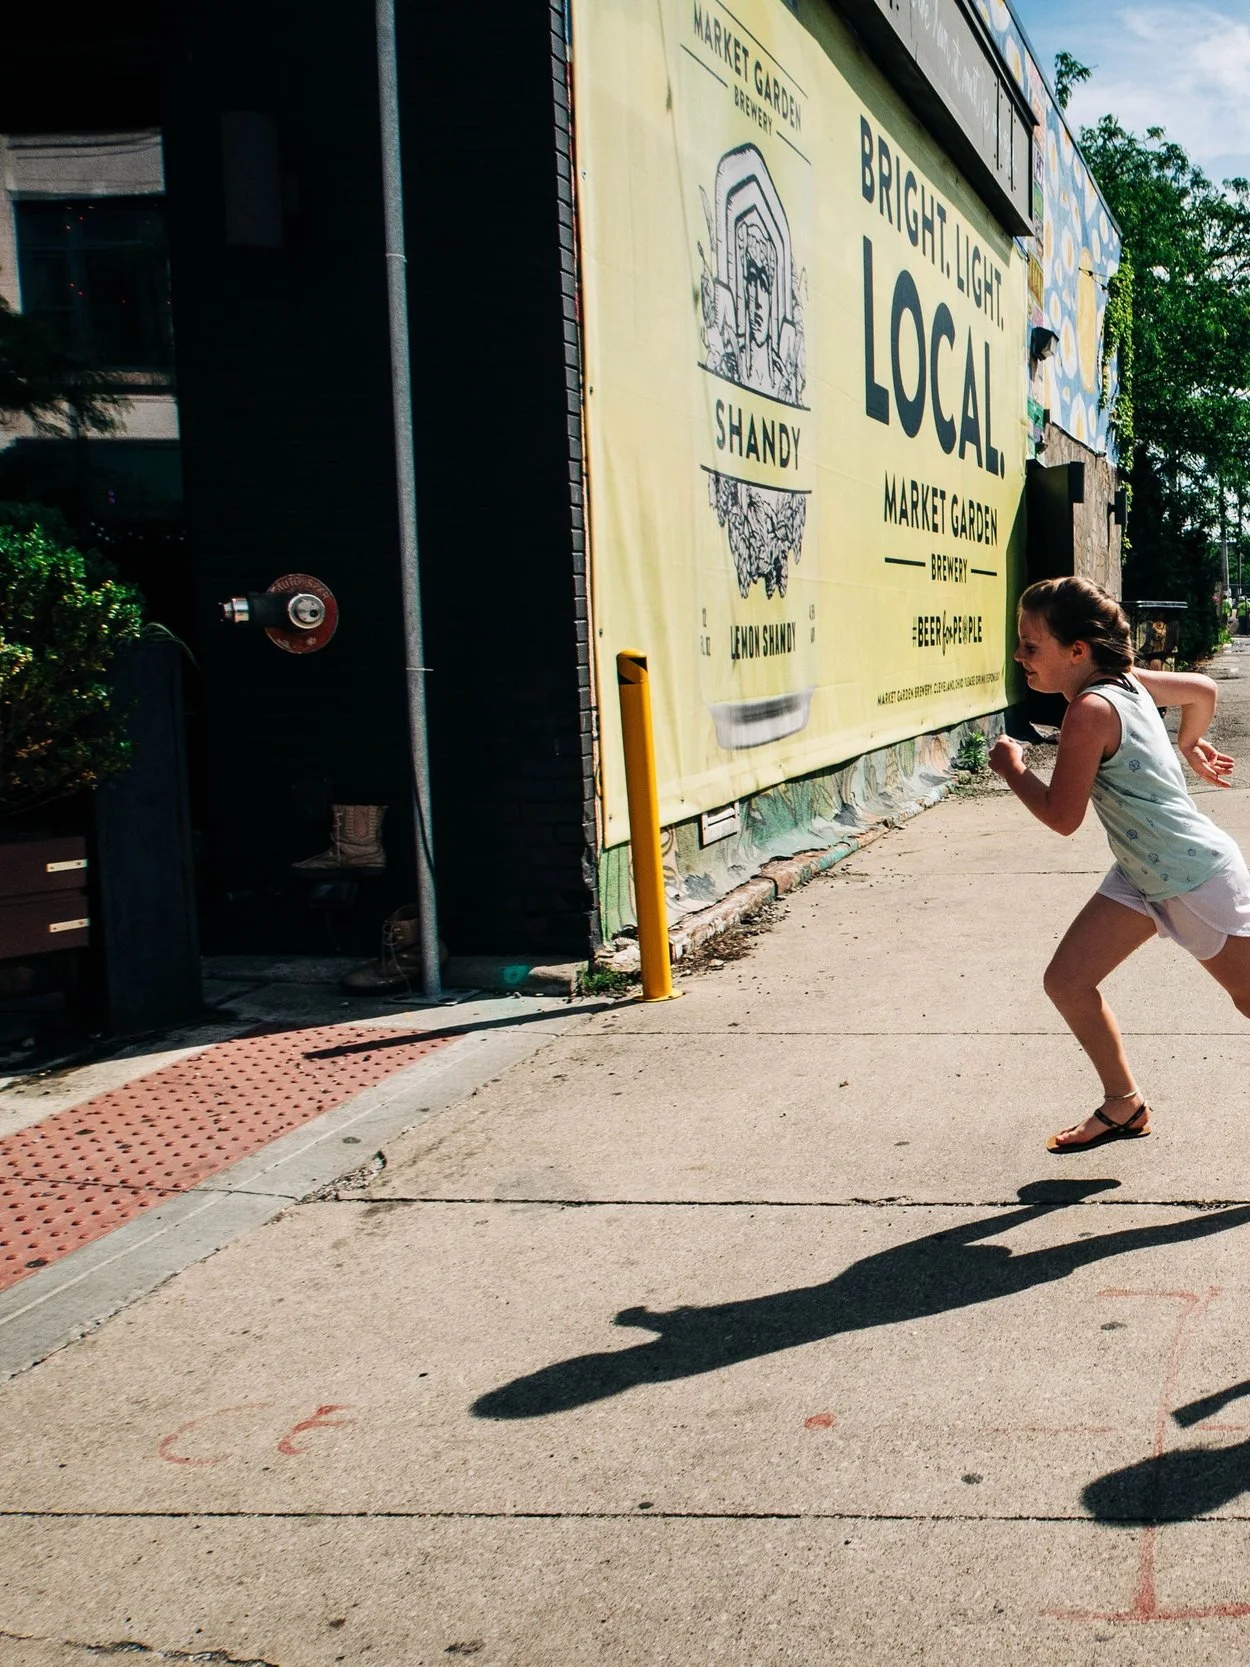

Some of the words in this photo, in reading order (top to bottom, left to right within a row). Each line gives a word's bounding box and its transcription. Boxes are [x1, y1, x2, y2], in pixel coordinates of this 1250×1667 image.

[693, 0, 749, 83] MARKET
[754, 60, 802, 133] GARDEN
[733, 84, 773, 136] BREWERY
[860, 113, 950, 280] BRIGHT.
[956, 223, 1004, 331] LIGHT.
[863, 234, 1005, 480] LOCAL.
[715, 398, 801, 471] SHANDY
[883, 470, 946, 535] MARKET
[951, 493, 998, 547] GARDEN
[931, 553, 968, 583] BREWERY
[730, 625, 760, 660] LEMON
[762, 622, 796, 657] SHANDY
